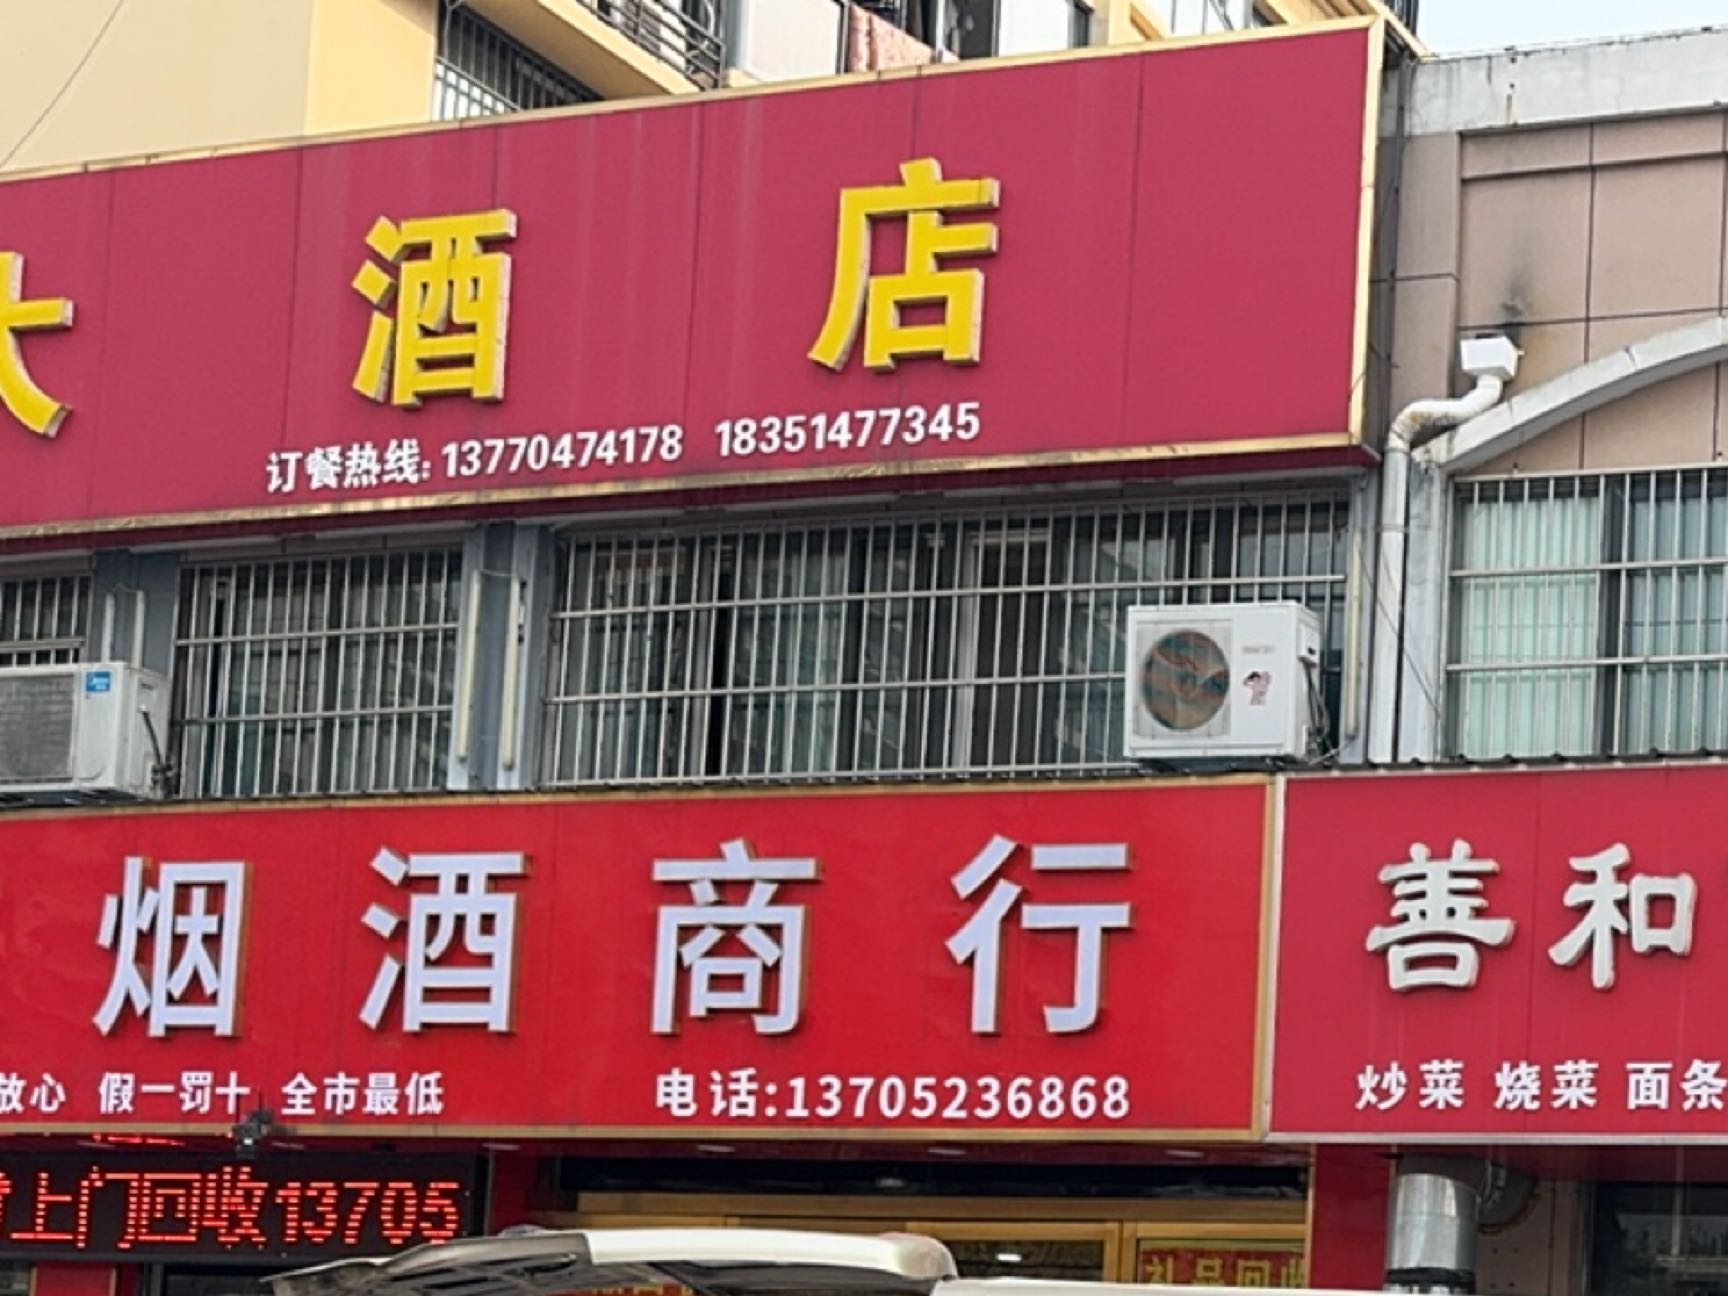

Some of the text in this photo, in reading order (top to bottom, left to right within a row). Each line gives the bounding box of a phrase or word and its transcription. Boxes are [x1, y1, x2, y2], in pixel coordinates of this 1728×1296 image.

[715, 402, 980, 458] 18351477345
[93, 834, 1133, 1039] 烟酒商行
[99, 1071, 251, 1115] 假一罚十
[280, 1071, 444, 1116] 全市最低
[655, 1067, 1131, 1119] 电话:13705236868
[1355, 1060, 1464, 1110] 炒菜
[1494, 1060, 1599, 1110] 烧菜
[1626, 1060, 1728, 1110] 面条
[0, 1166, 460, 1250] 上门回收13705
